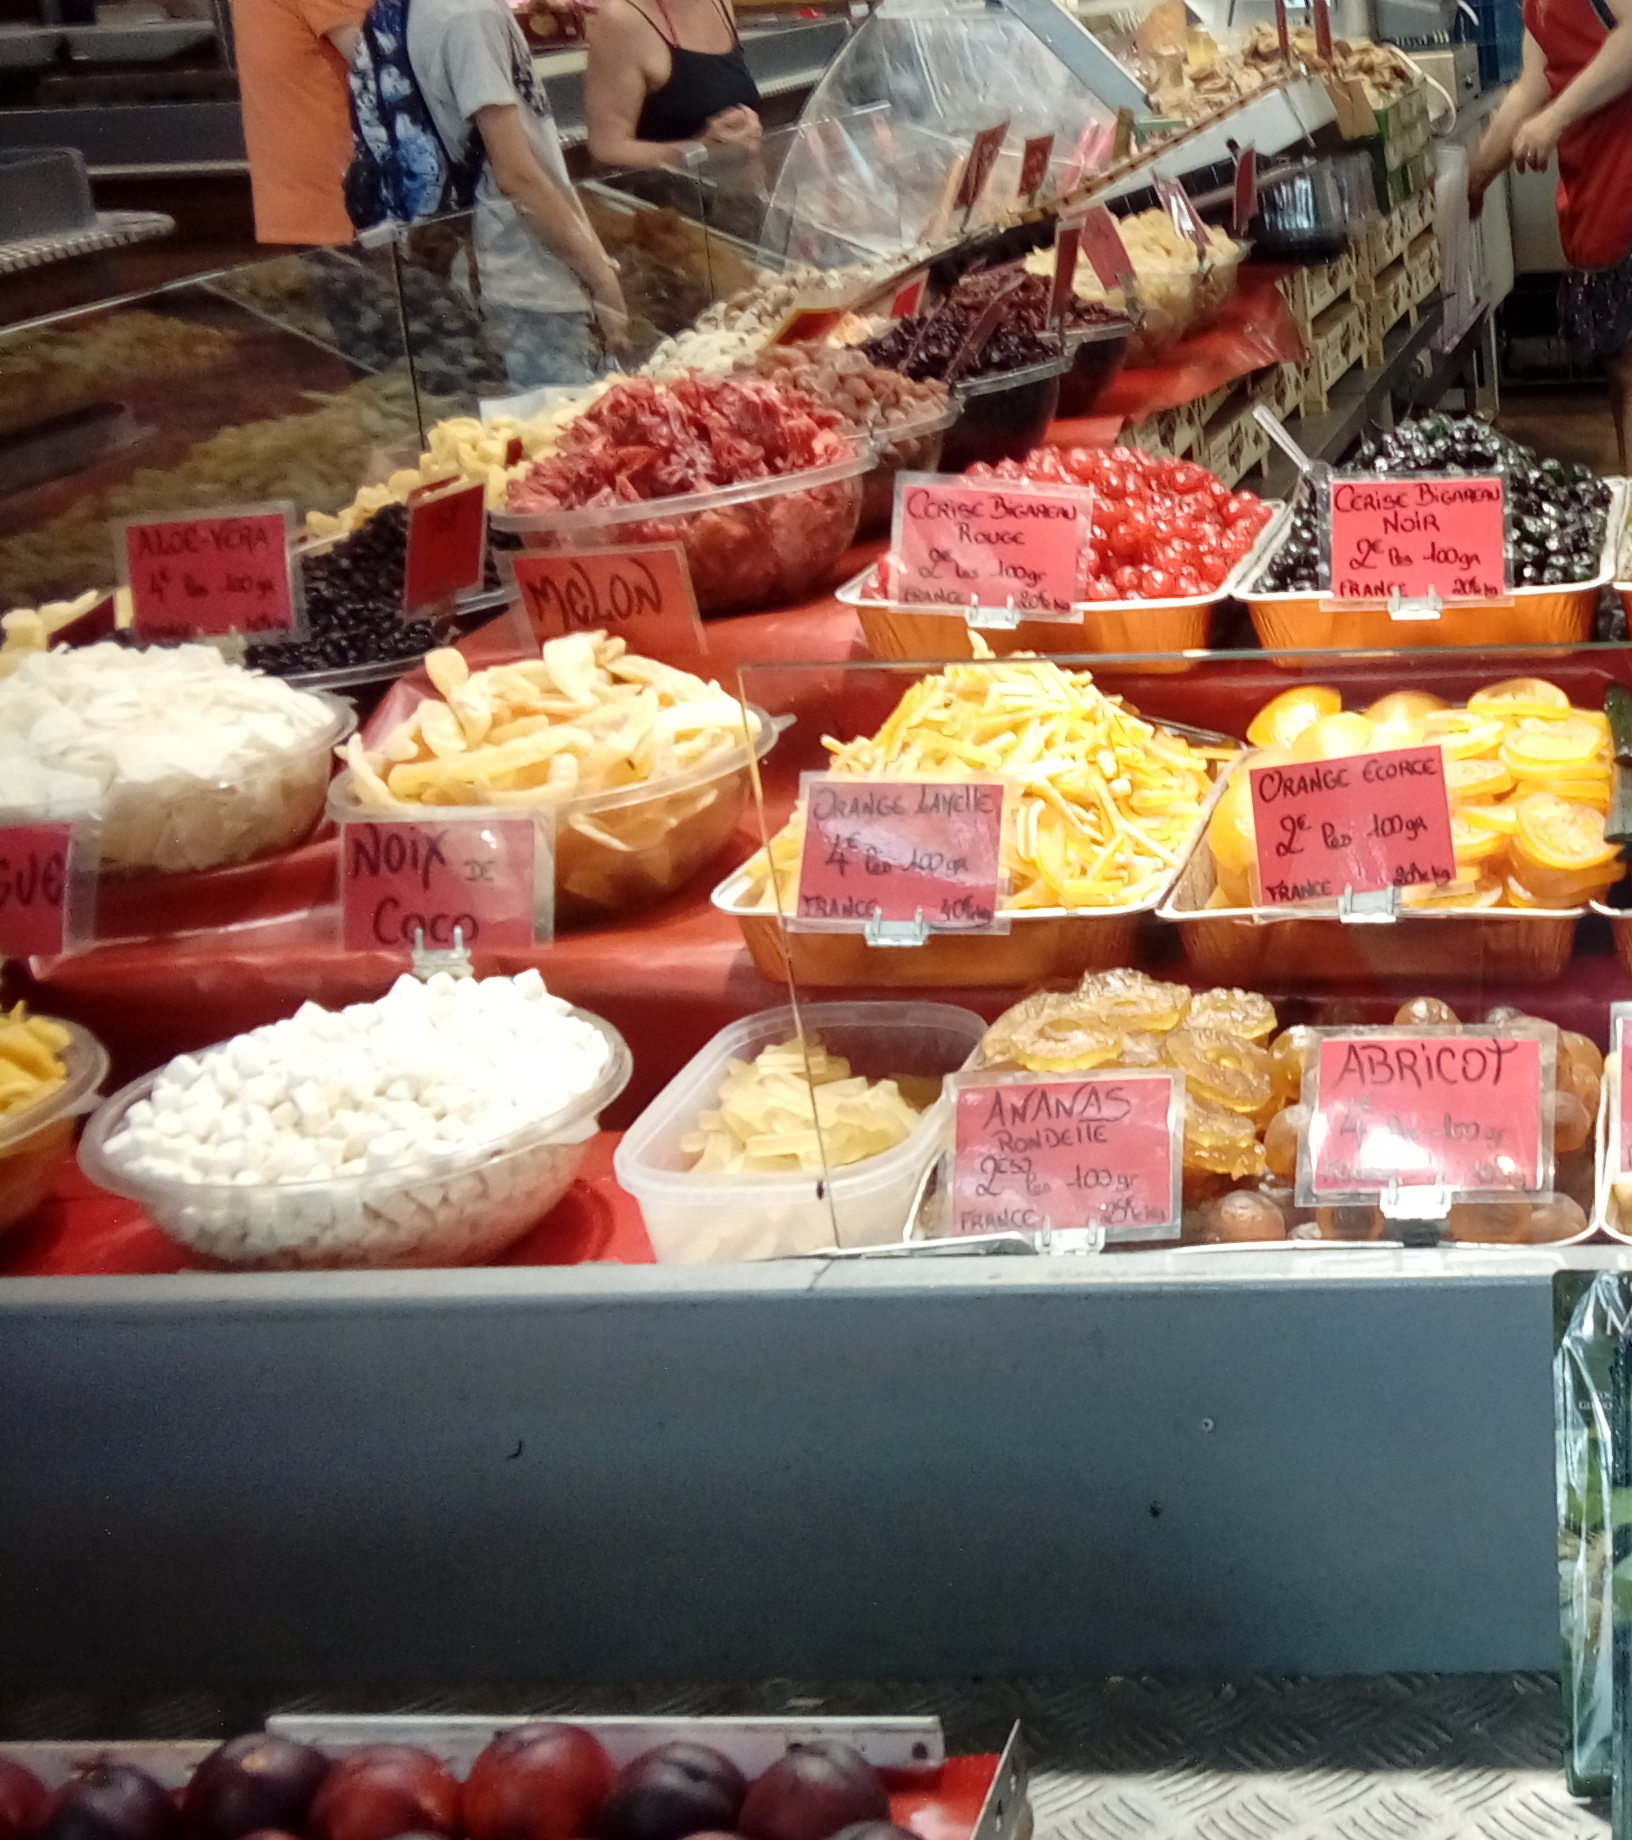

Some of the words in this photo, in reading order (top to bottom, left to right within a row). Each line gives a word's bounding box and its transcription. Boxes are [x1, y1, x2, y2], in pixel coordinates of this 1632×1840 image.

[907, 490, 985, 520] CERISE
[1334, 485, 1408, 513] CERISE
[958, 522, 1026, 545] ROUGE
[1383, 510, 1441, 535] NOIR
[525, 557, 663, 632] MELON
[1258, 768, 1351, 803] ORANGE
[1363, 758, 1437, 783] ECORCE
[813, 787, 905, 820] ORANGE
[352, 822, 449, 892] NOIX
[464, 860, 496, 882] DE
[1266, 880, 1333, 902] FRANCE
[373, 897, 480, 945] COCO
[1334, 1037, 1518, 1088] ABRICOT
[983, 1082, 1132, 1130] ANANAS
[992, 1124, 1110, 1152] RONDELLE
[960, 1209, 1035, 1232] FRANCE
